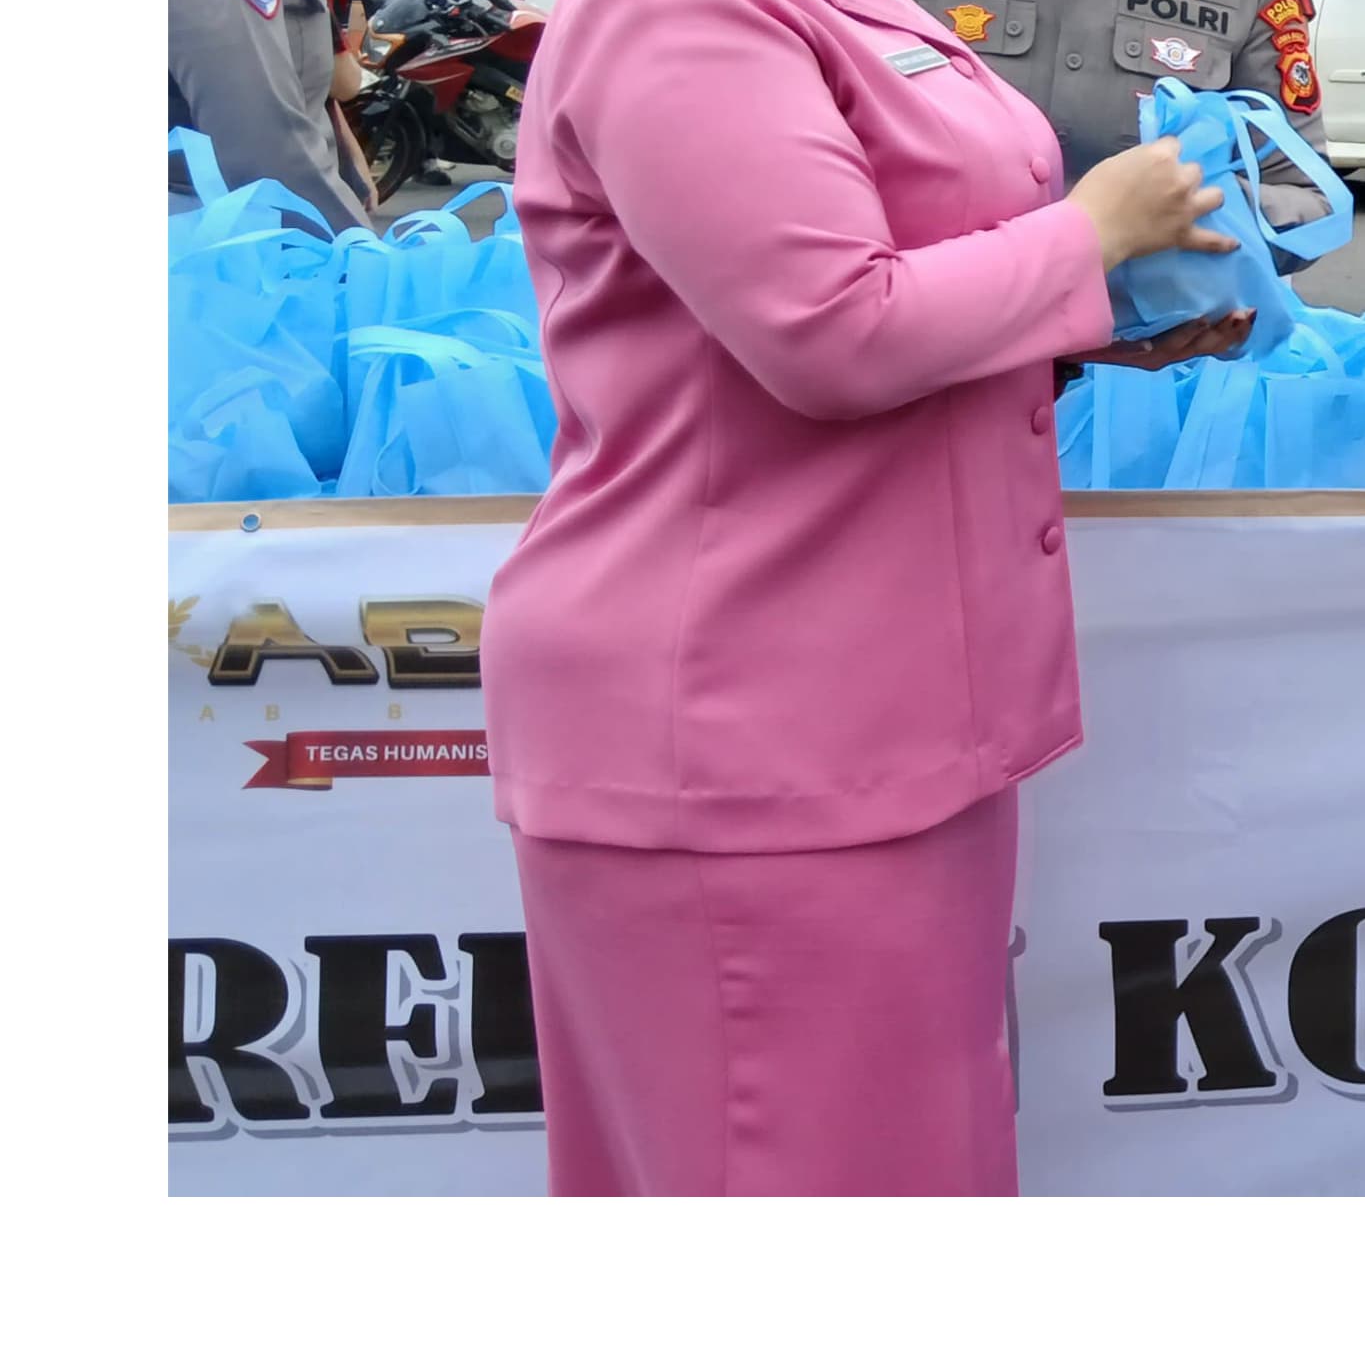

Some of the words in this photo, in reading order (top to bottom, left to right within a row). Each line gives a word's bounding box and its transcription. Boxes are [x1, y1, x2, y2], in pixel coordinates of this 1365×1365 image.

[208, 596, 482, 689] AB
[306, 745, 378, 761] TEGAS
[384, 743, 487, 761] HUMANIS
